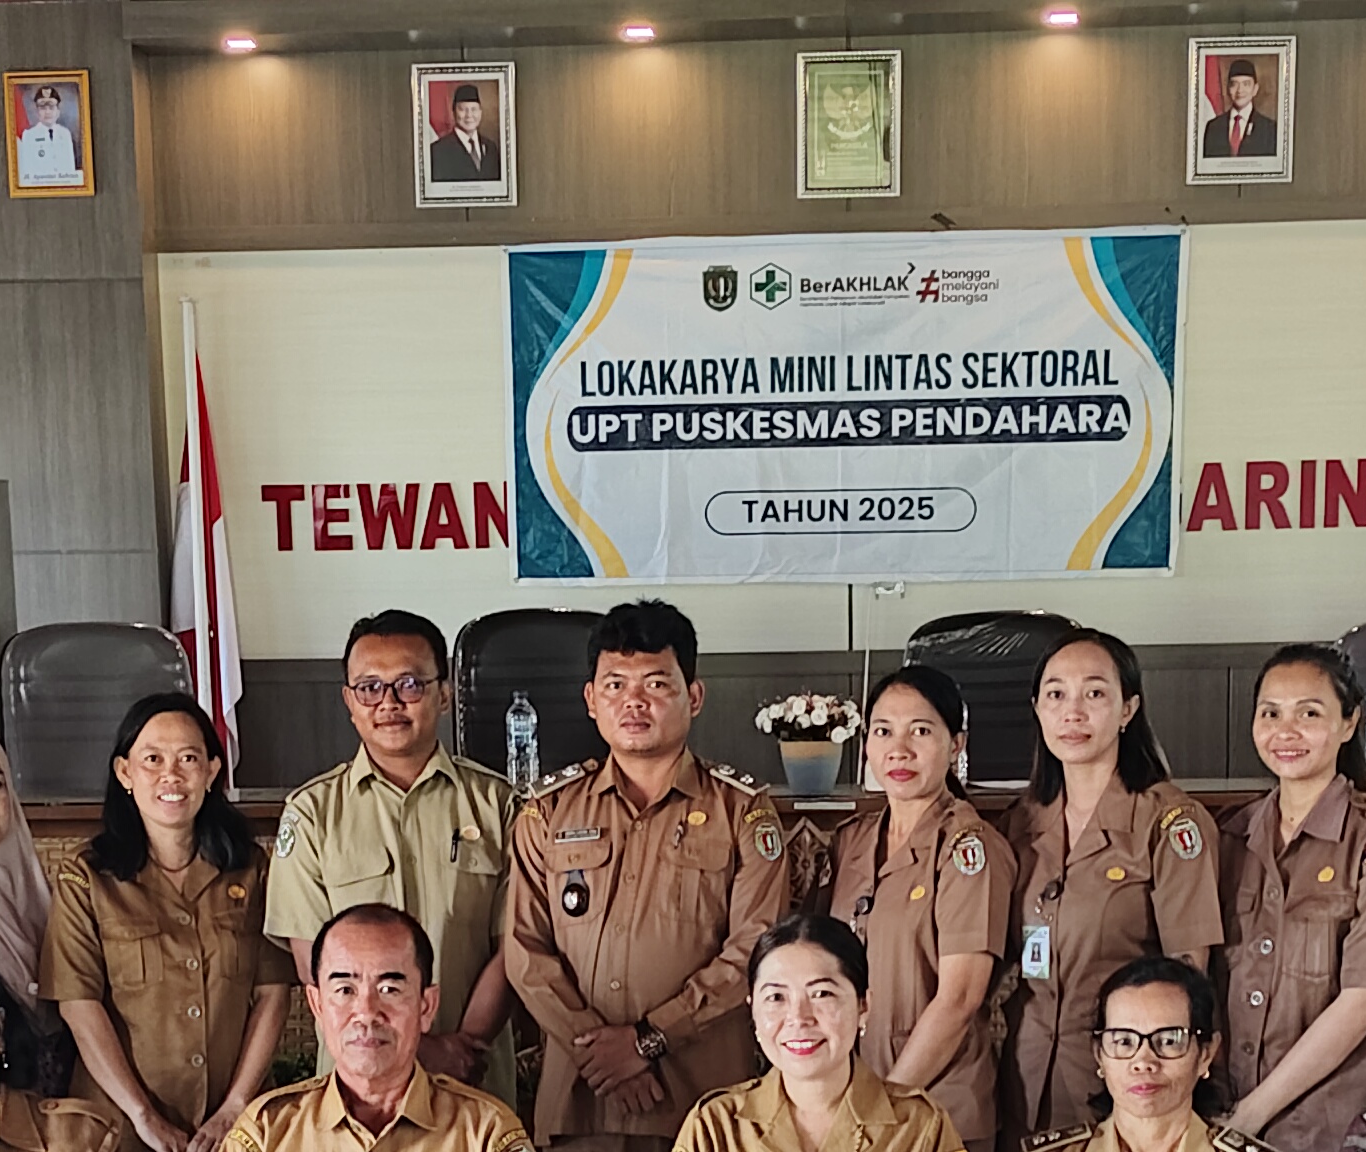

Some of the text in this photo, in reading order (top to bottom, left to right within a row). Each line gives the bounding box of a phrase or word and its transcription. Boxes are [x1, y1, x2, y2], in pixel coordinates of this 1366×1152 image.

[800, 275, 909, 293] BerAKHLAK
[941, 269, 990, 281] bangga
[941, 293, 988, 305] bangsa
[580, 349, 1119, 398] LOKAKARYA MINI LINTAS SEKTORAL
[571, 403, 1130, 443] UPT PUSKESMAS PENDAHARA
[742, 496, 935, 523] TAHUN 2025
